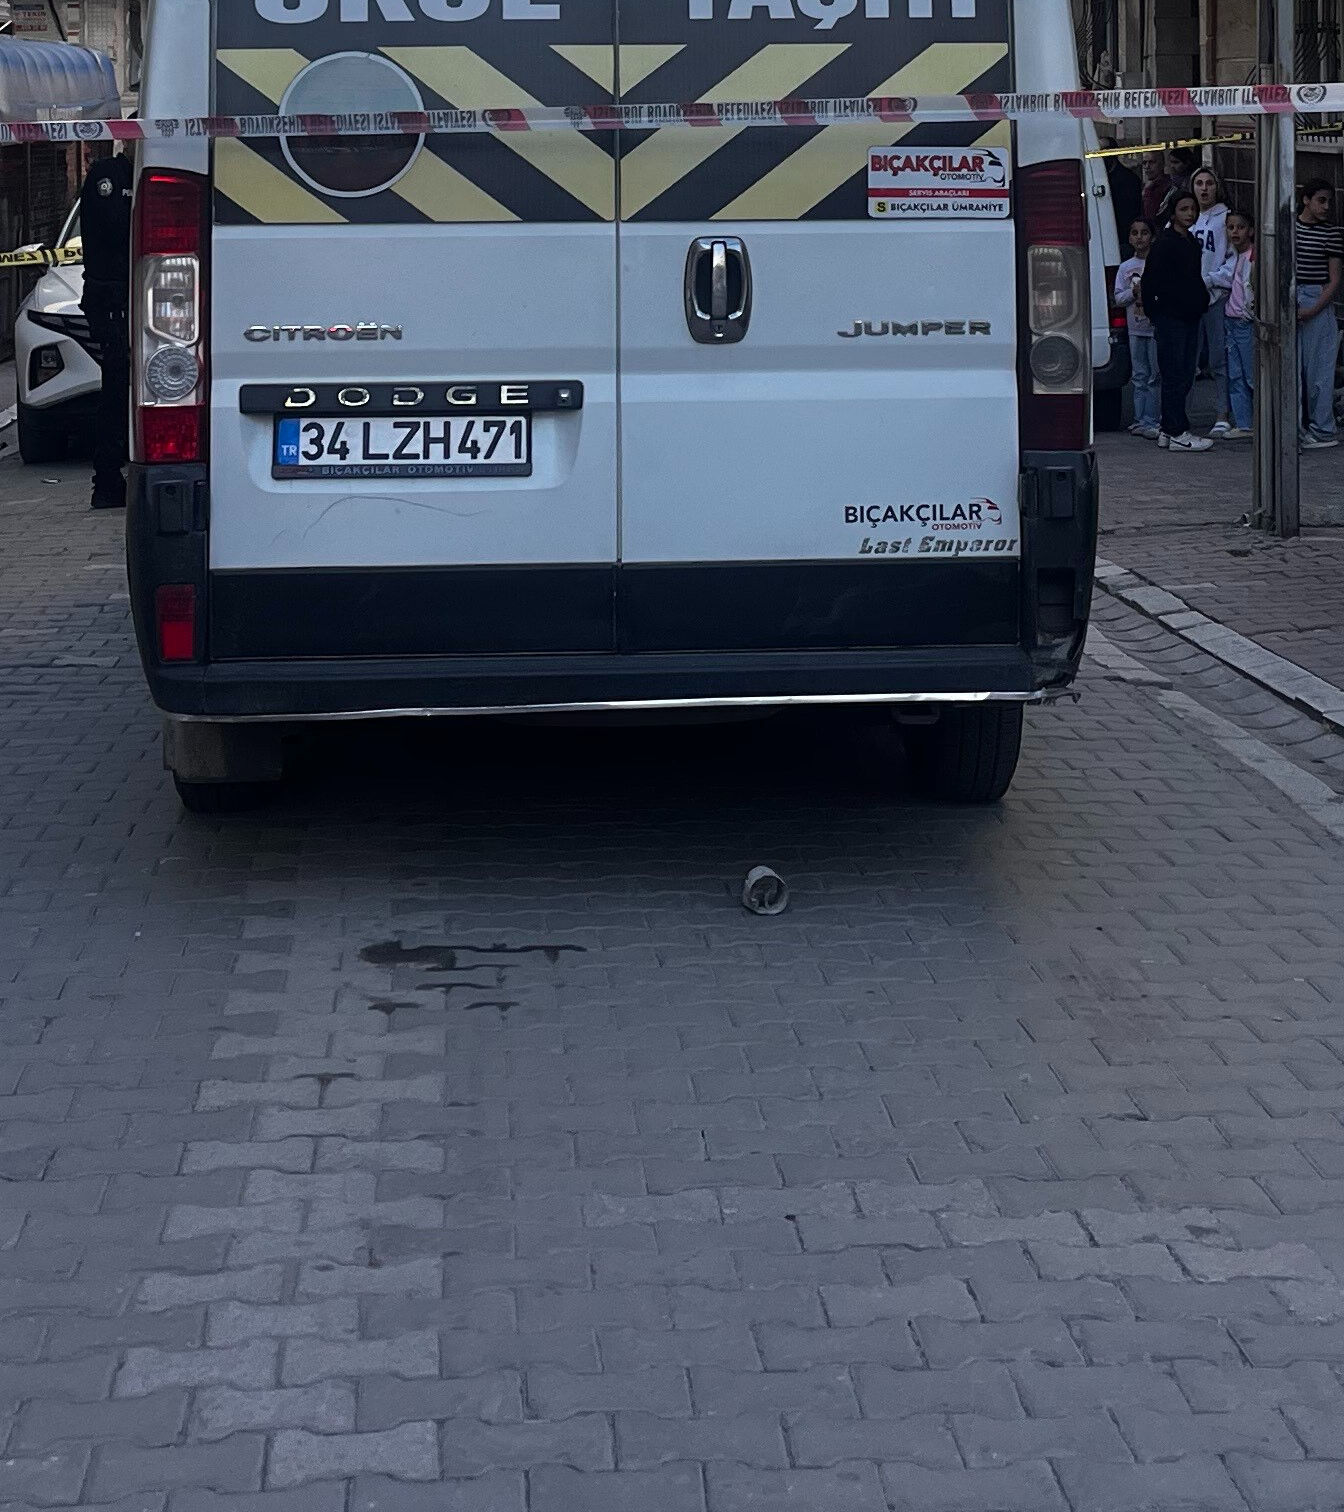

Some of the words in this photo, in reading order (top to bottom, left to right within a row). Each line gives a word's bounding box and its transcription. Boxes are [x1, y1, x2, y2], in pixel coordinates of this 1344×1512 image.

[871, 154, 985, 177] BIÇAKÇILAR
[890, 203, 949, 214] BIÇAKÇILAR
[837, 320, 991, 338] JUMPER
[284, 385, 529, 407] DODGE
[281, 445, 297, 456] TR
[301, 421, 350, 461] 34
[362, 421, 451, 461] LZH
[458, 420, 522, 460] 471
[844, 504, 982, 528] BIÇAKÇILAR
[858, 537, 912, 554] Last
[917, 535, 1018, 557] Emperor
